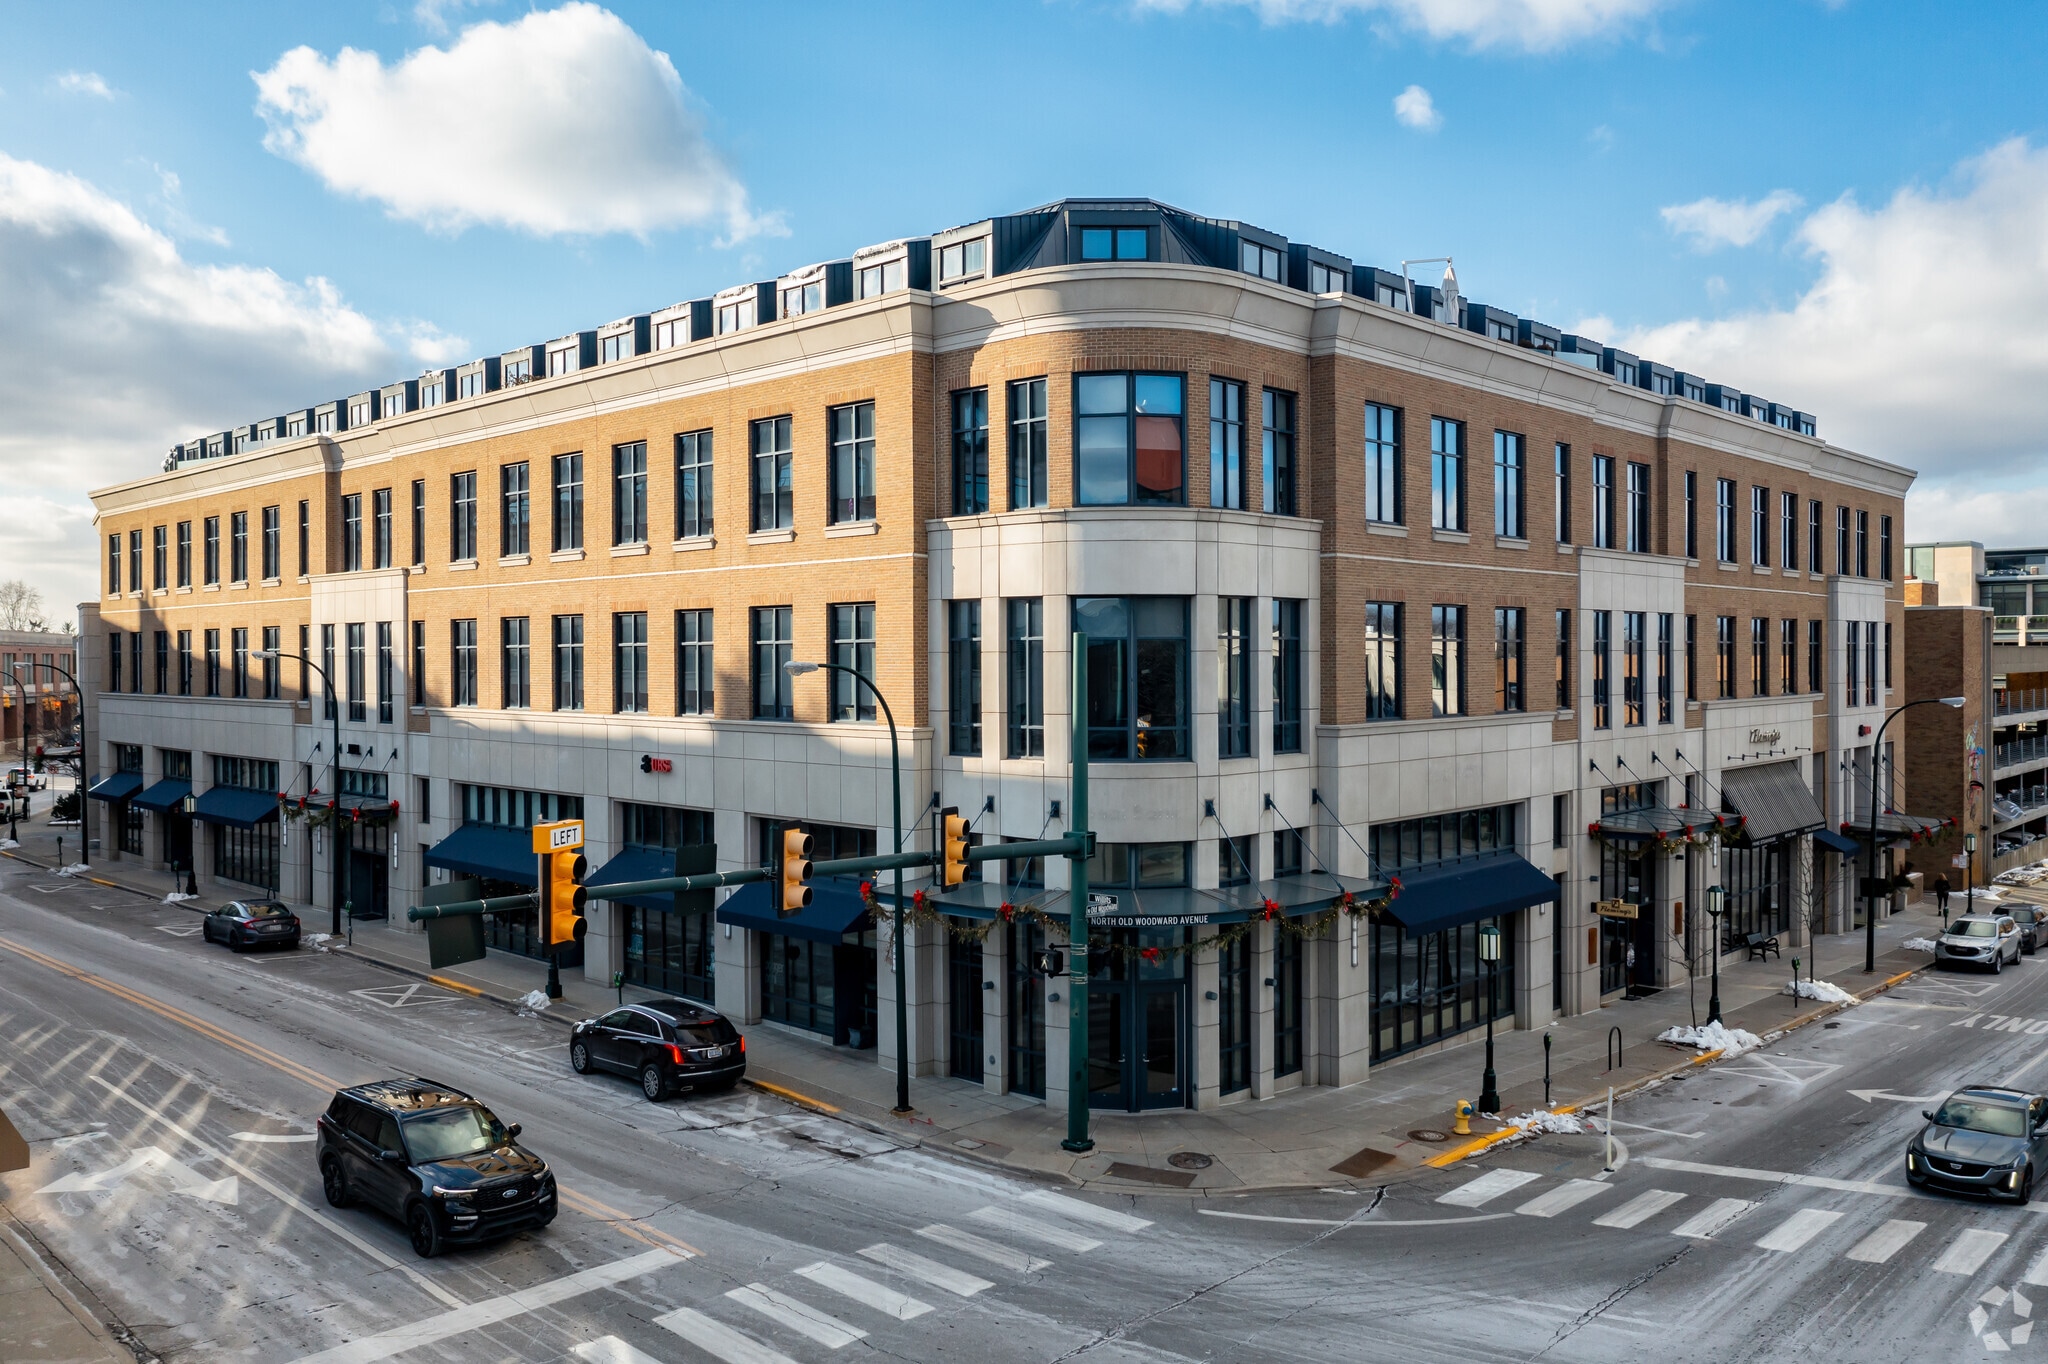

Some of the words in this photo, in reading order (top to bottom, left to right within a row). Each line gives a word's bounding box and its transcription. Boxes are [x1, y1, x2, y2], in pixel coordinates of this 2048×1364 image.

[651, 758, 671, 772] UBS
[553, 827, 577, 846] LEFT
[1091, 917, 1116, 926] NORTH
[1118, 917, 1133, 926] OLD
[1135, 916, 1178, 925] WOODWARD
[1180, 915, 1209, 924] AVENUE
[1949, 1013, 2048, 1034] ONLY
